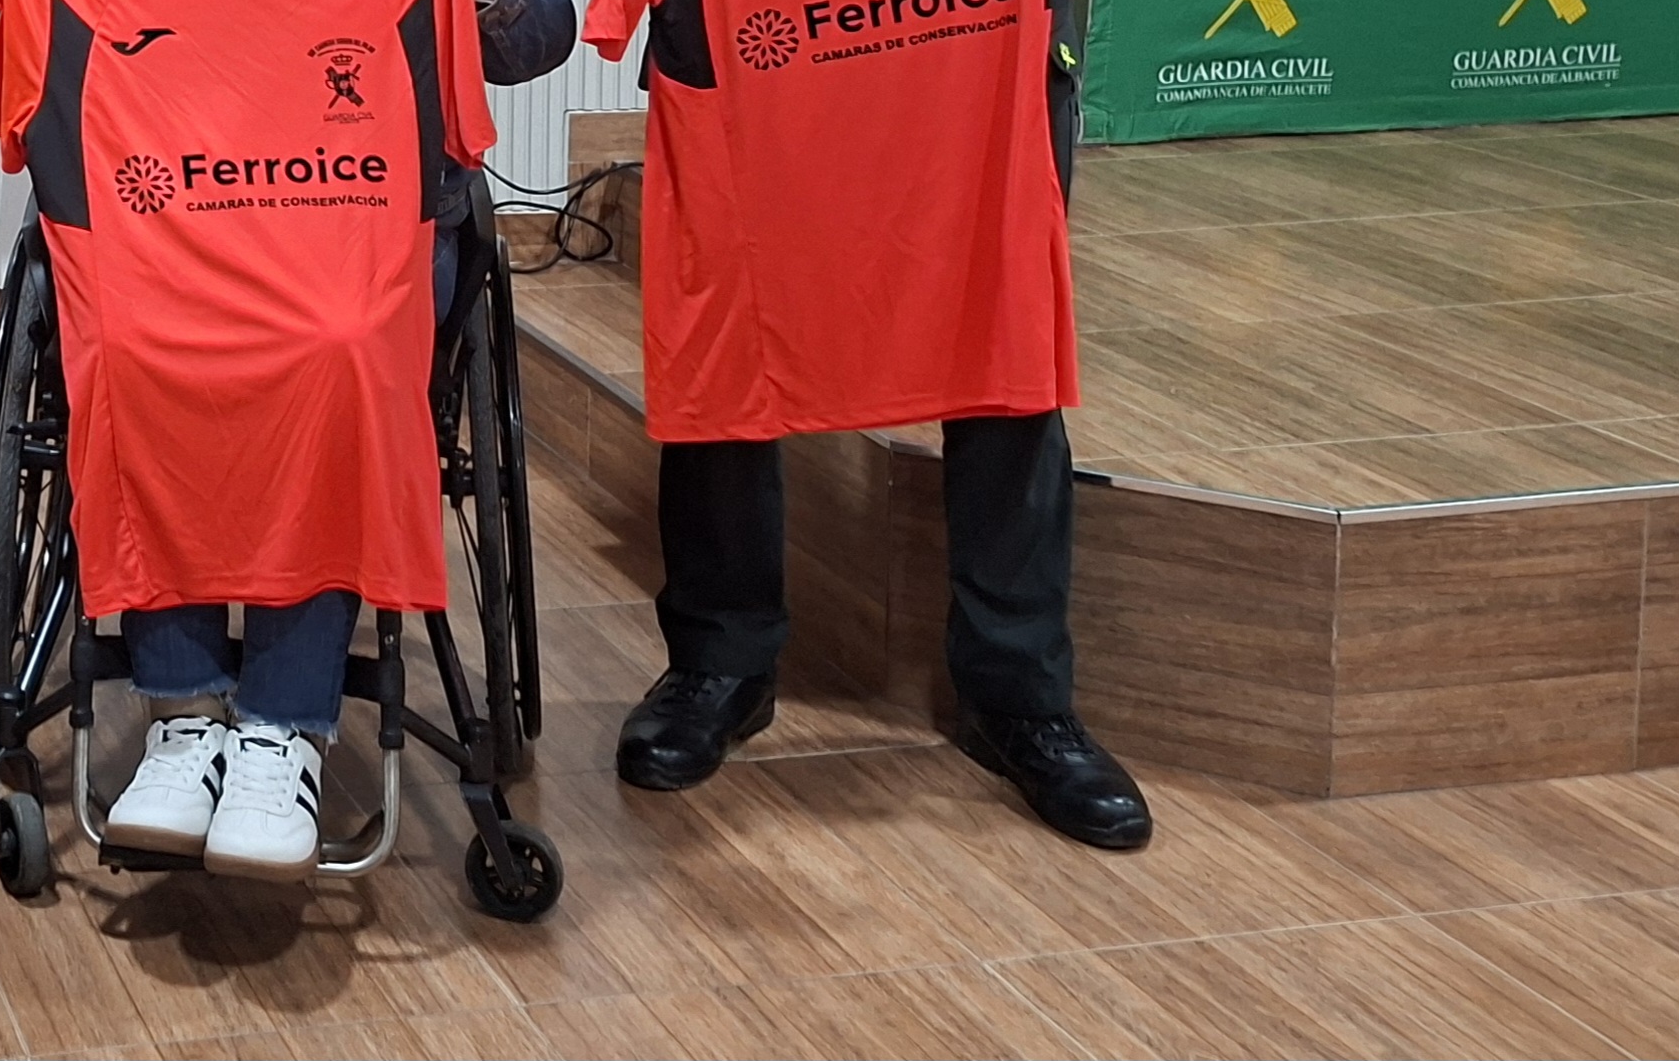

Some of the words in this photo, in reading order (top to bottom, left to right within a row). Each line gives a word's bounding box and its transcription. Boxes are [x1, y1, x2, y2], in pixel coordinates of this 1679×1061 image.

[885, 37, 905, 51] DE
[908, 13, 1018, 47] CONSERVACIÓN
[1157, 60, 1266, 86] GUARDIA
[1269, 57, 1335, 79] CIVIL
[1453, 47, 1558, 72] GUARDIA
[1561, 42, 1622, 66] CIVIL
[1155, 85, 1248, 103] COMANDANCIA
[1249, 84, 1266, 98] DE
[1266, 82, 1332, 96] ALBACETE
[1450, 73, 1540, 90] COMANDANCIA
[1540, 71, 1557, 86] DE
[1557, 69, 1620, 85] ALBACETE
[180, 146, 389, 190] Ferroice
[259, 197, 277, 209] DE
[279, 194, 389, 208] CONSERVACIÓN
